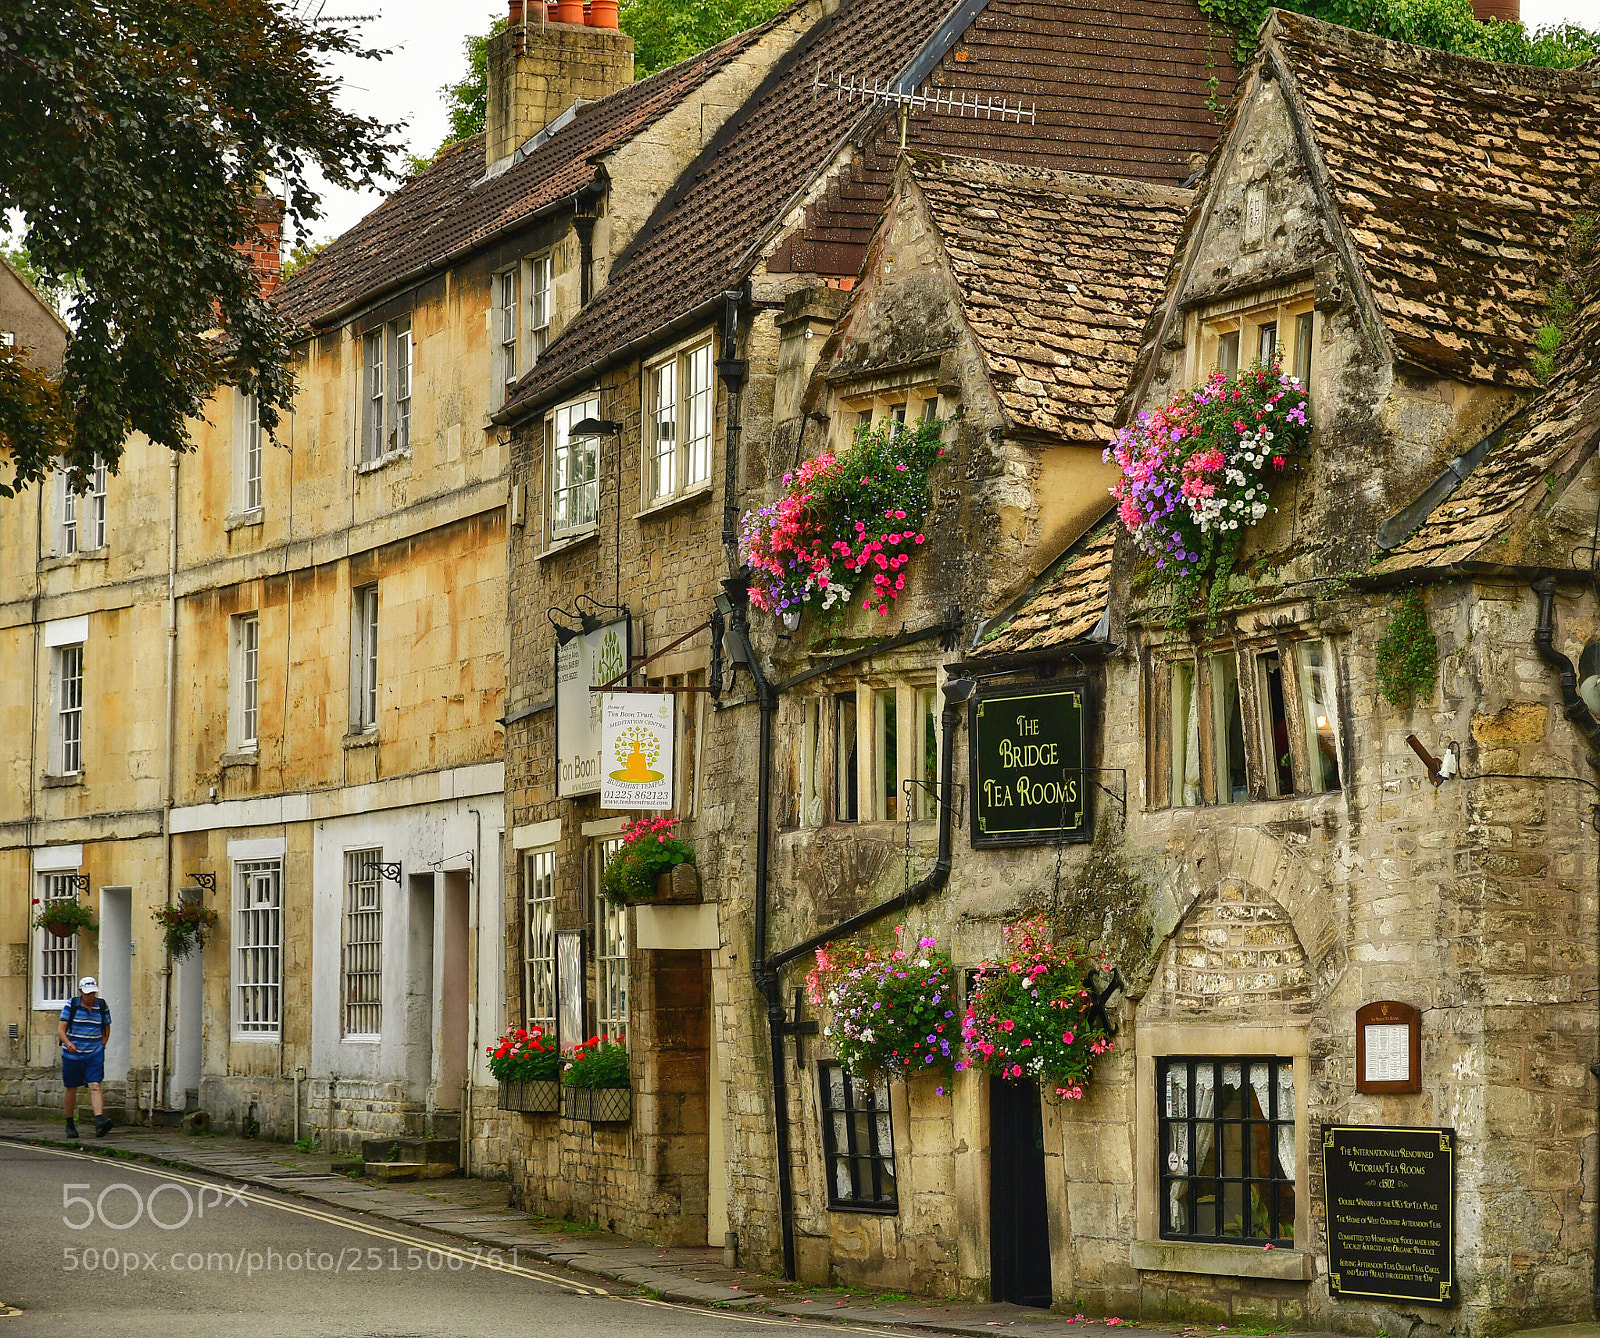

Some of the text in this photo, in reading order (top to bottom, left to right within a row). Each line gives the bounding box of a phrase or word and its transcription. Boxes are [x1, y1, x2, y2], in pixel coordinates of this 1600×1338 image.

[1016, 715, 1040, 736] THE
[998, 738, 1060, 768] BRIDGE
[574, 755, 596, 778] Boon
[604, 790, 668, 800] 01225 862123
[984, 776, 1077, 807] TEA ROOMS
